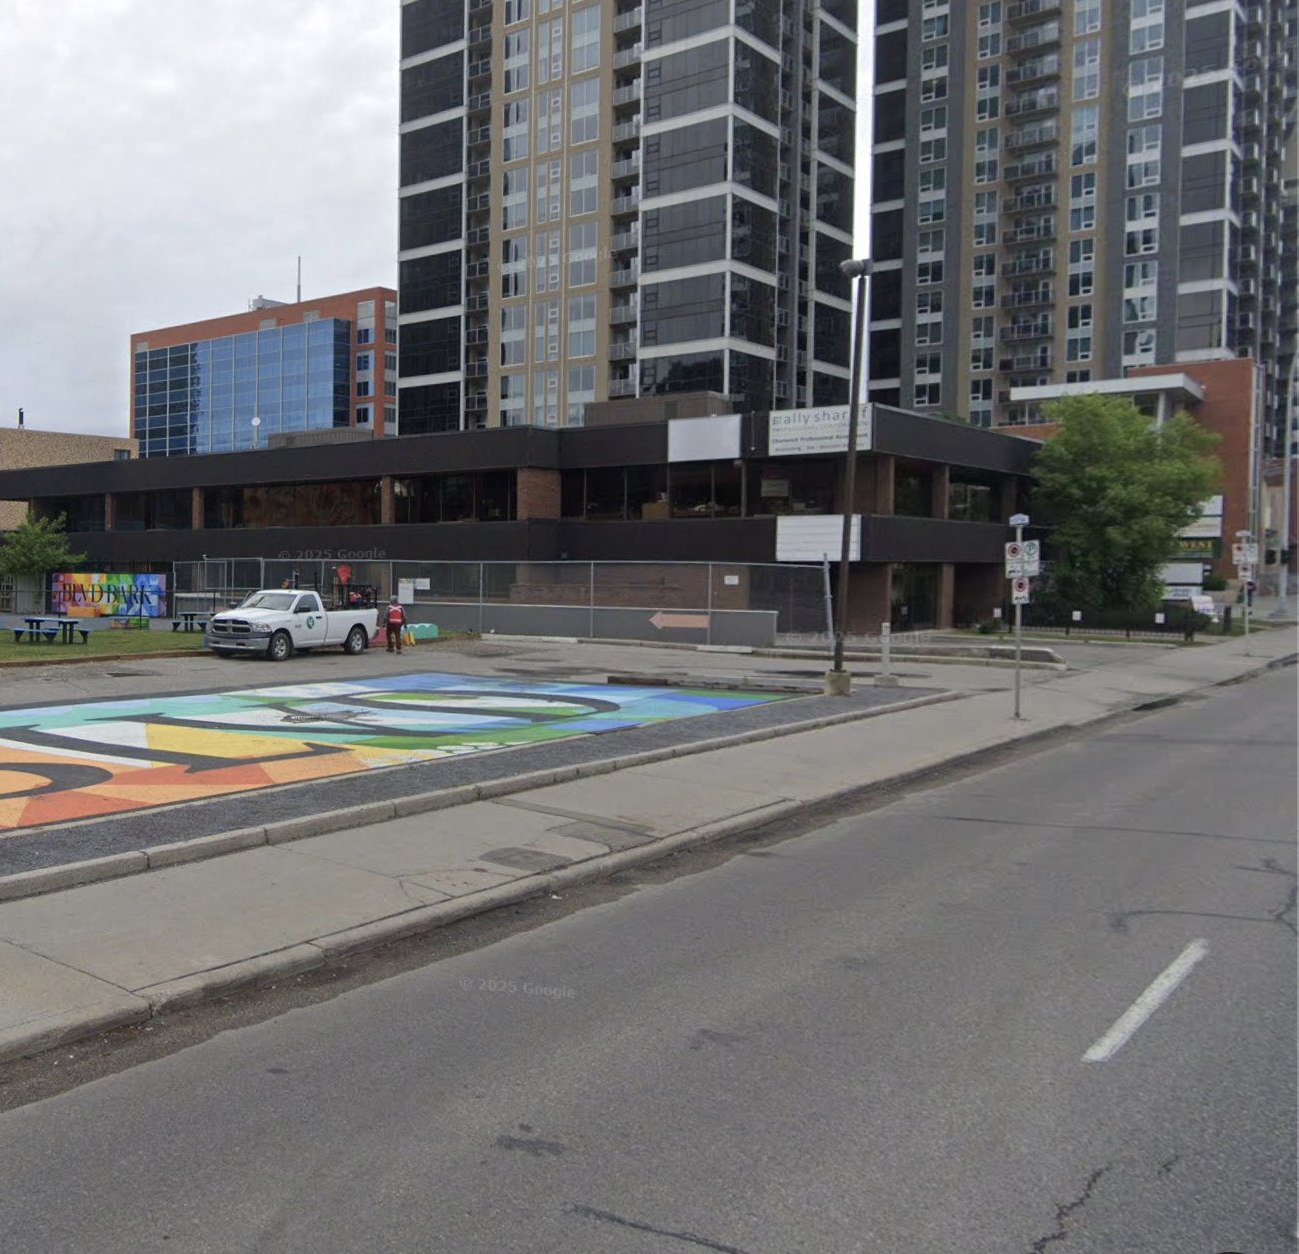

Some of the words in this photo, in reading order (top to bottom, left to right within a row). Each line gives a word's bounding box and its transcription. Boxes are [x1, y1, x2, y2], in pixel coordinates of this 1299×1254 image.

[814, 406, 868, 421] sharf
[1180, 541, 1212, 551] WEST
[62, 583, 103, 603] BLVD
[107, 583, 152, 604] BARK
